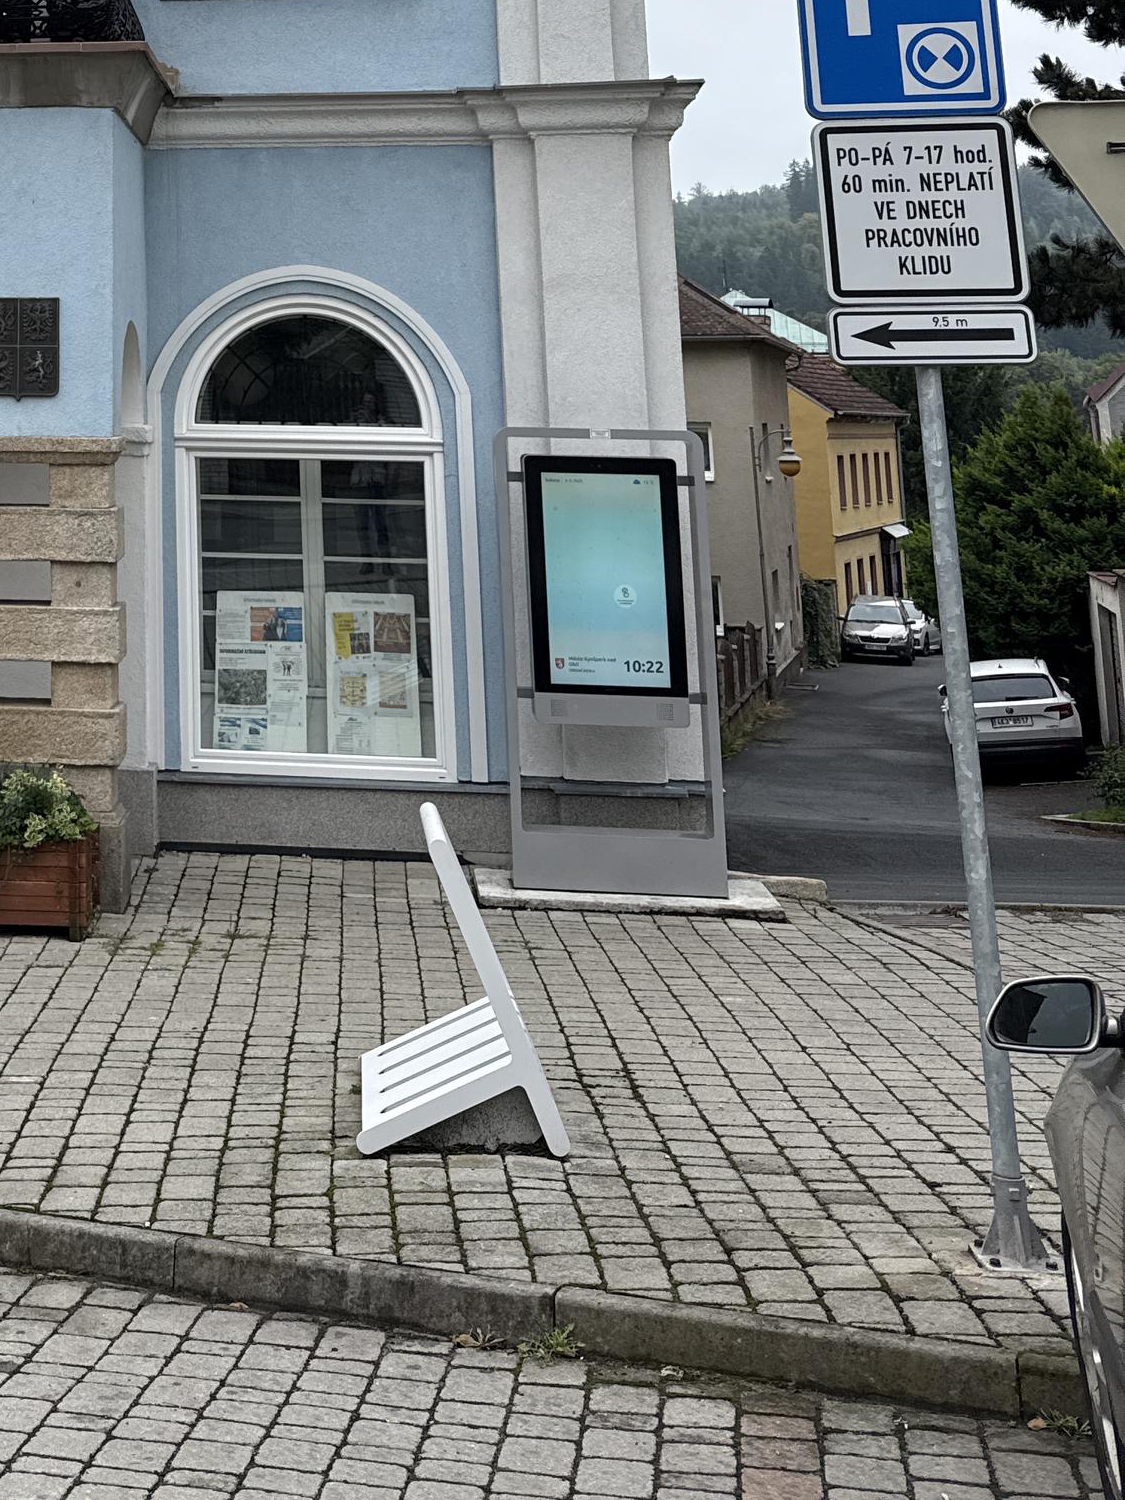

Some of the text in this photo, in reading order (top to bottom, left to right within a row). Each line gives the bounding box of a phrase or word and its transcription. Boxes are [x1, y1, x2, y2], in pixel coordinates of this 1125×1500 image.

[836, 141, 993, 167] PO-PÁ 7-17 hod.
[841, 166, 994, 194] 60 min. NEPLATÍ
[873, 199, 966, 220] VE DNECH
[865, 222, 980, 248] PRACOVNÍHO
[898, 255, 952, 276] KLIDU
[956, 318, 968, 327] m
[624, 660, 664, 673] 10:22
